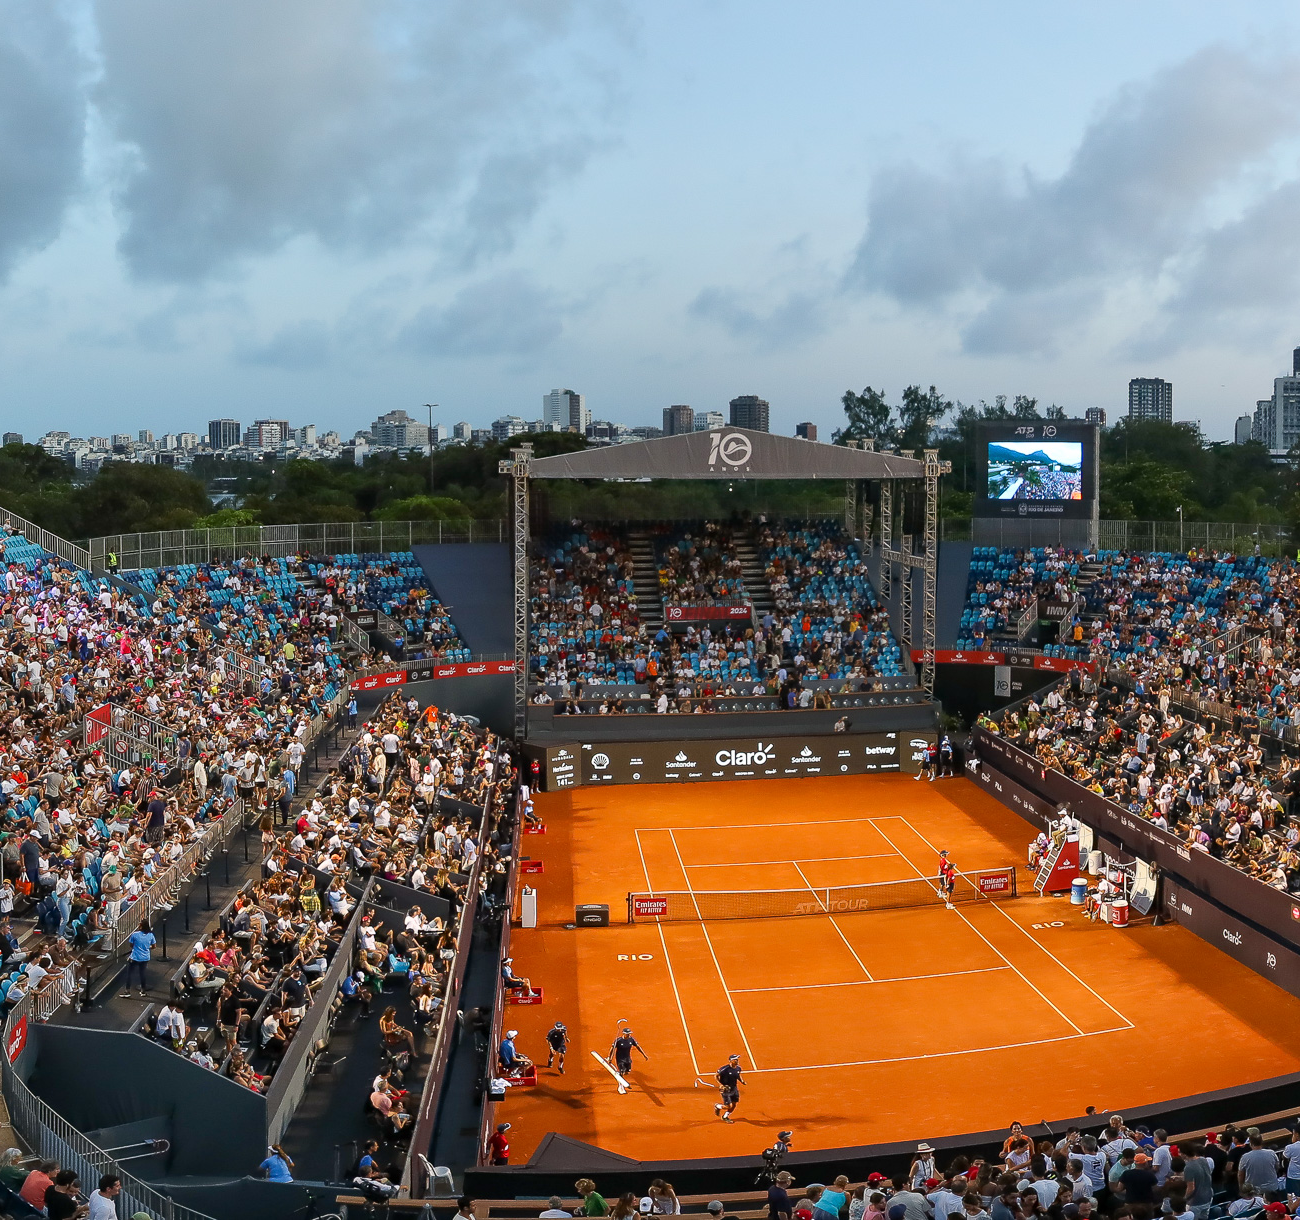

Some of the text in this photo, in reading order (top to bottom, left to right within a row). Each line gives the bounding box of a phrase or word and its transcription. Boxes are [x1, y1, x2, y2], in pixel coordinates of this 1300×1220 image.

[1014, 426, 1035, 434] ATP
[1042, 425, 1057, 437] 10
[708, 432, 752, 466] 10
[729, 607, 748, 615] 2024
[438, 666, 456, 677] Claro
[467, 664, 486, 674] Claro
[364, 678, 378, 688] Claro
[385, 674, 402, 684] Claro
[715, 742, 776, 766] Claro
[865, 746, 896, 755] betway
[556, 779, 568, 787] 141
[1057, 863, 1076, 871] Santander
[979, 876, 1008, 886] Emirates
[635, 901, 667, 909] Emirates
[830, 898, 868, 910] TOUR
[1031, 920, 1065, 930] RIO
[1222, 928, 1242, 946] Claro
[617, 953, 654, 962] RIO
